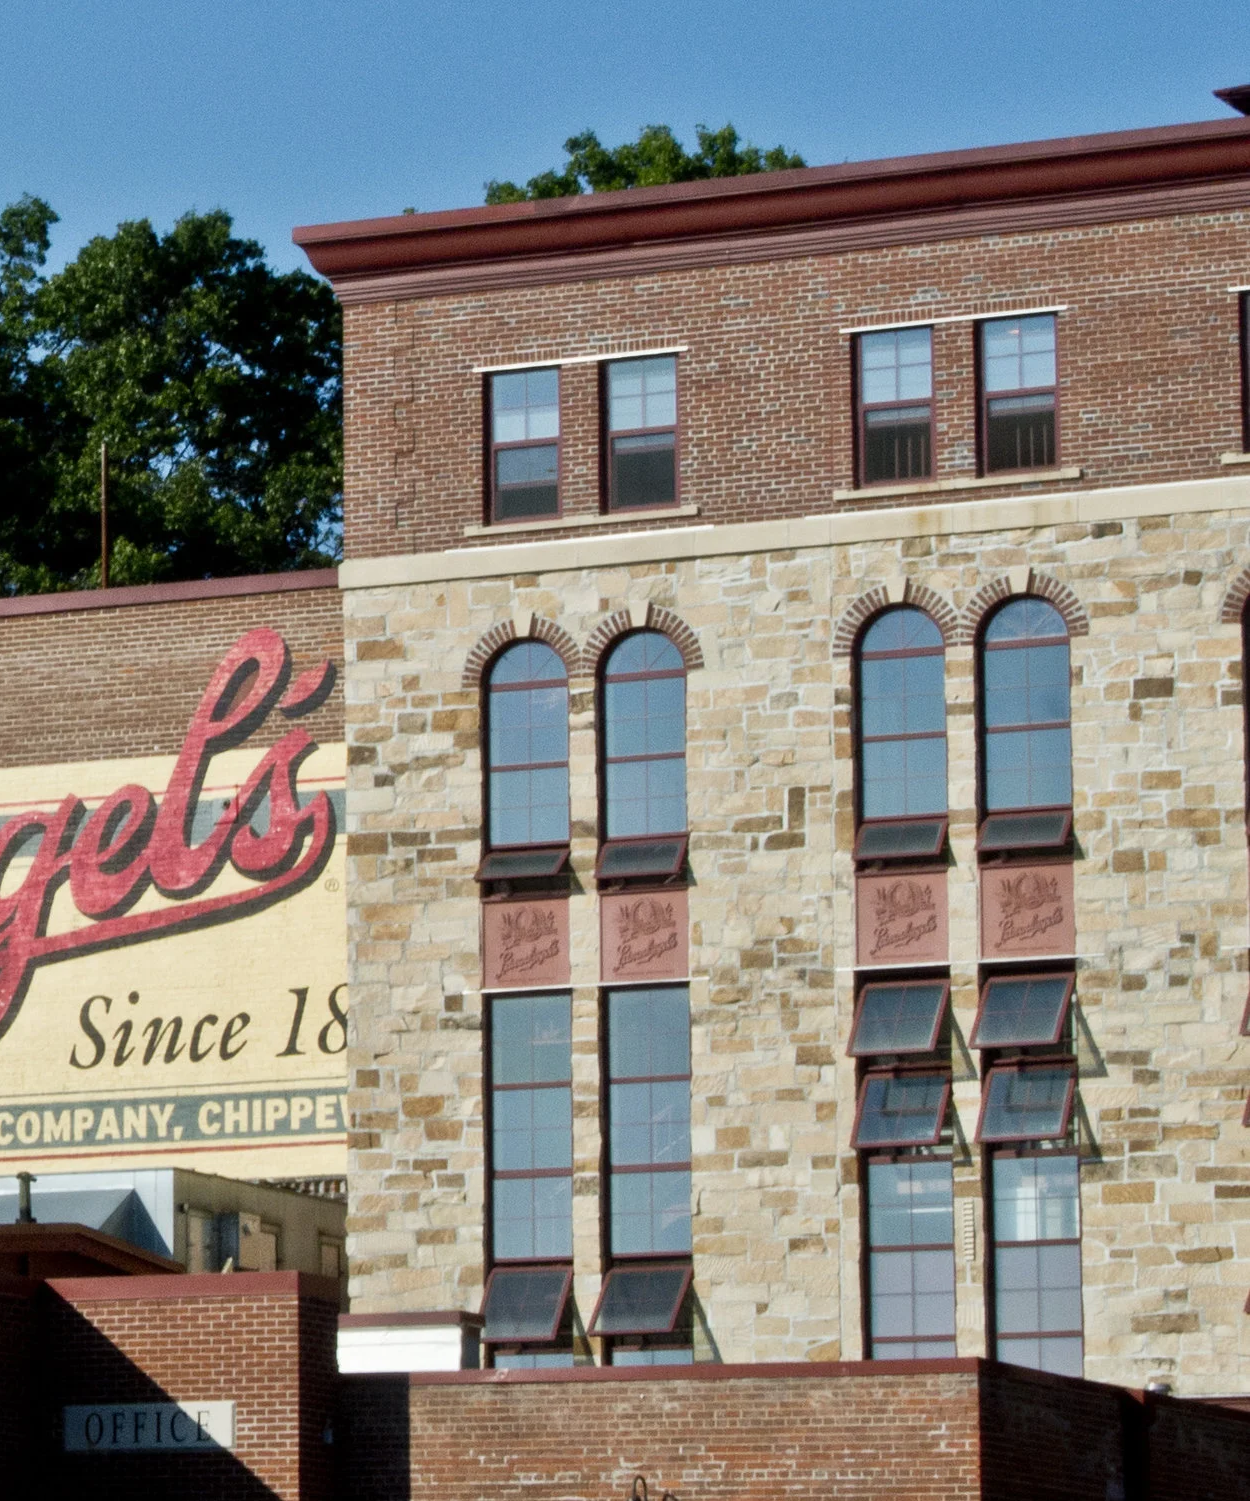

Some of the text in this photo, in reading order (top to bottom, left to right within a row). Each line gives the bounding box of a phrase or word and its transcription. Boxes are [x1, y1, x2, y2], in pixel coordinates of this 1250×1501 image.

[69, 990, 250, 1070] Since
[199, 1094, 349, 1134] CHIPPE
[84, 1410, 212, 1445] OFFICE
